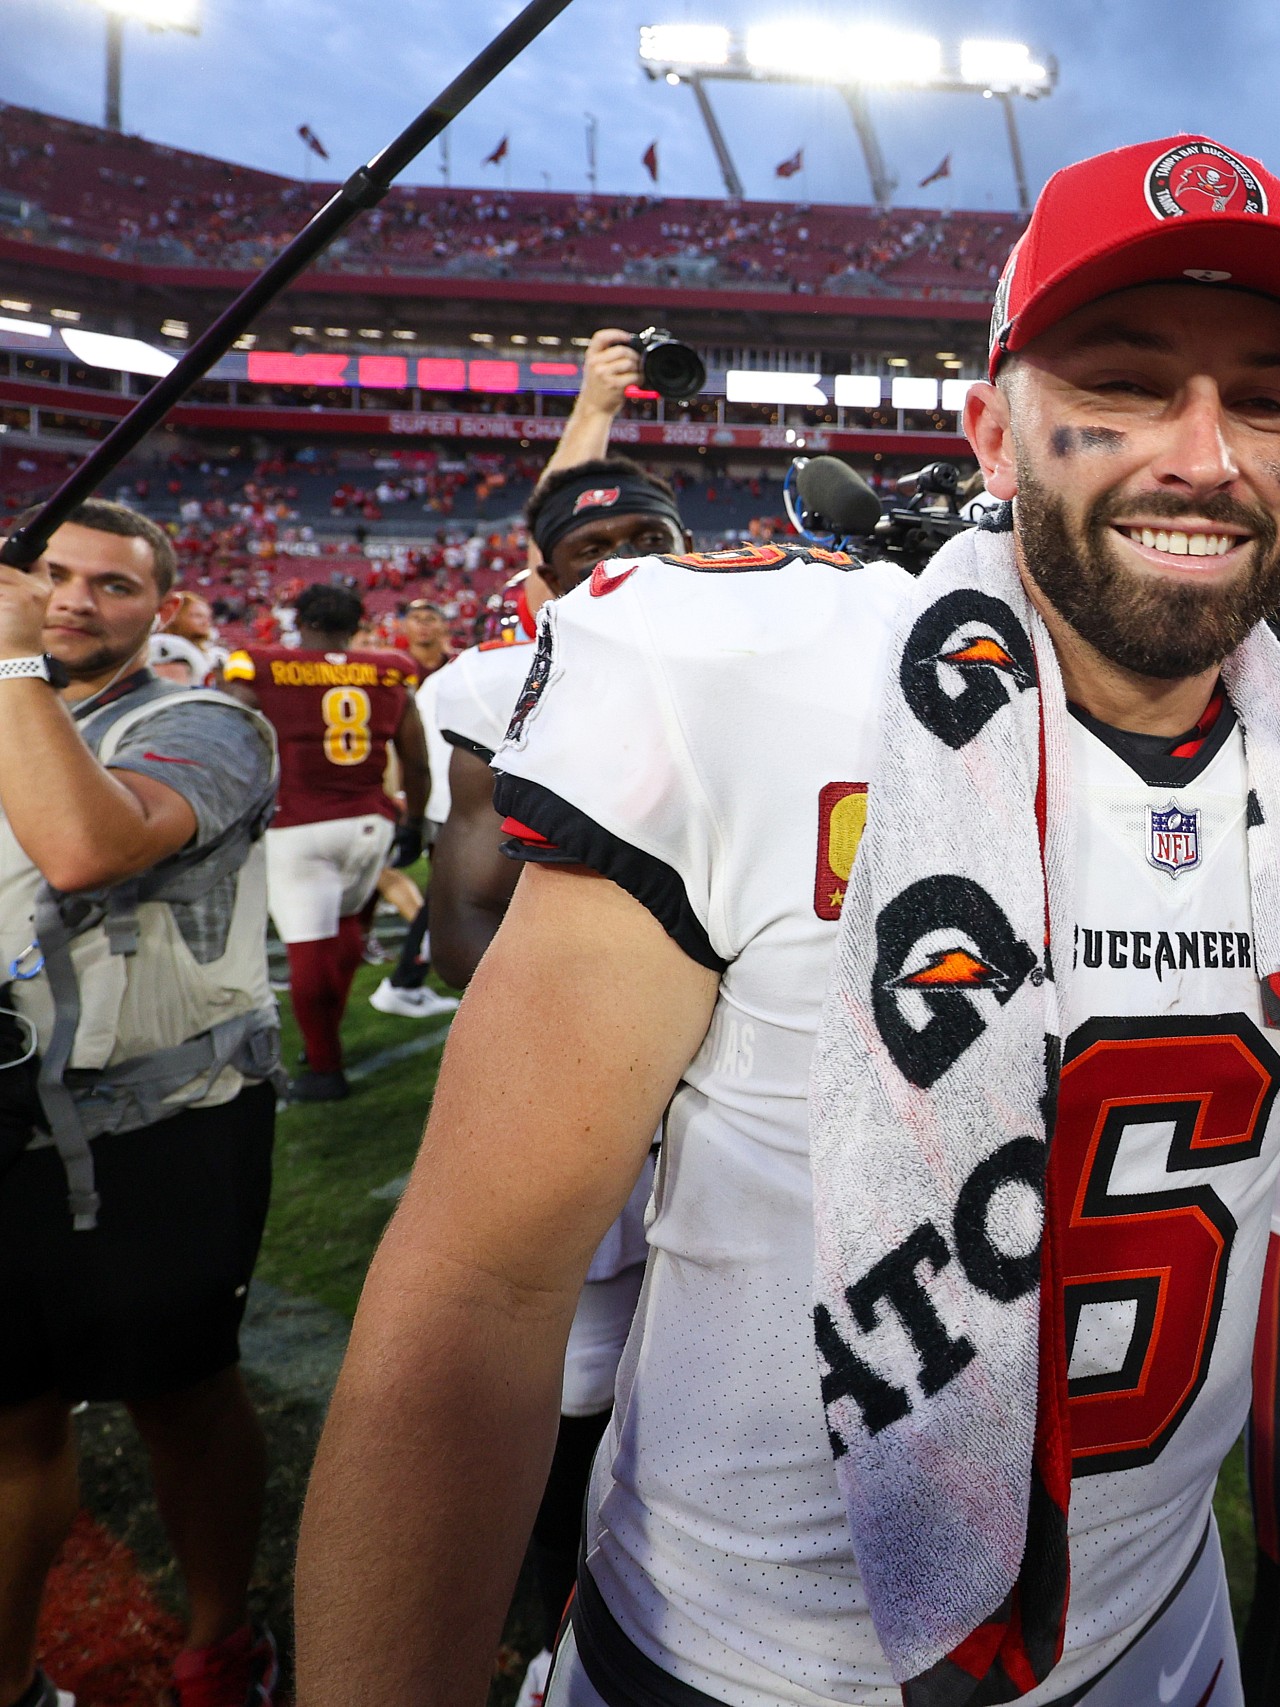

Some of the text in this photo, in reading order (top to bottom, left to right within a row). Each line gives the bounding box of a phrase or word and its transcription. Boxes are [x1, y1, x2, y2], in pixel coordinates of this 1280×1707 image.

[1155, 145, 1257, 192] TAMPA BAY BUCCANEERS
[270, 660, 379, 687] ROBINSON
[321, 685, 372, 767] 8
[1156, 833, 1195, 864] NFL
[1073, 922, 1258, 983] UCCANEER
